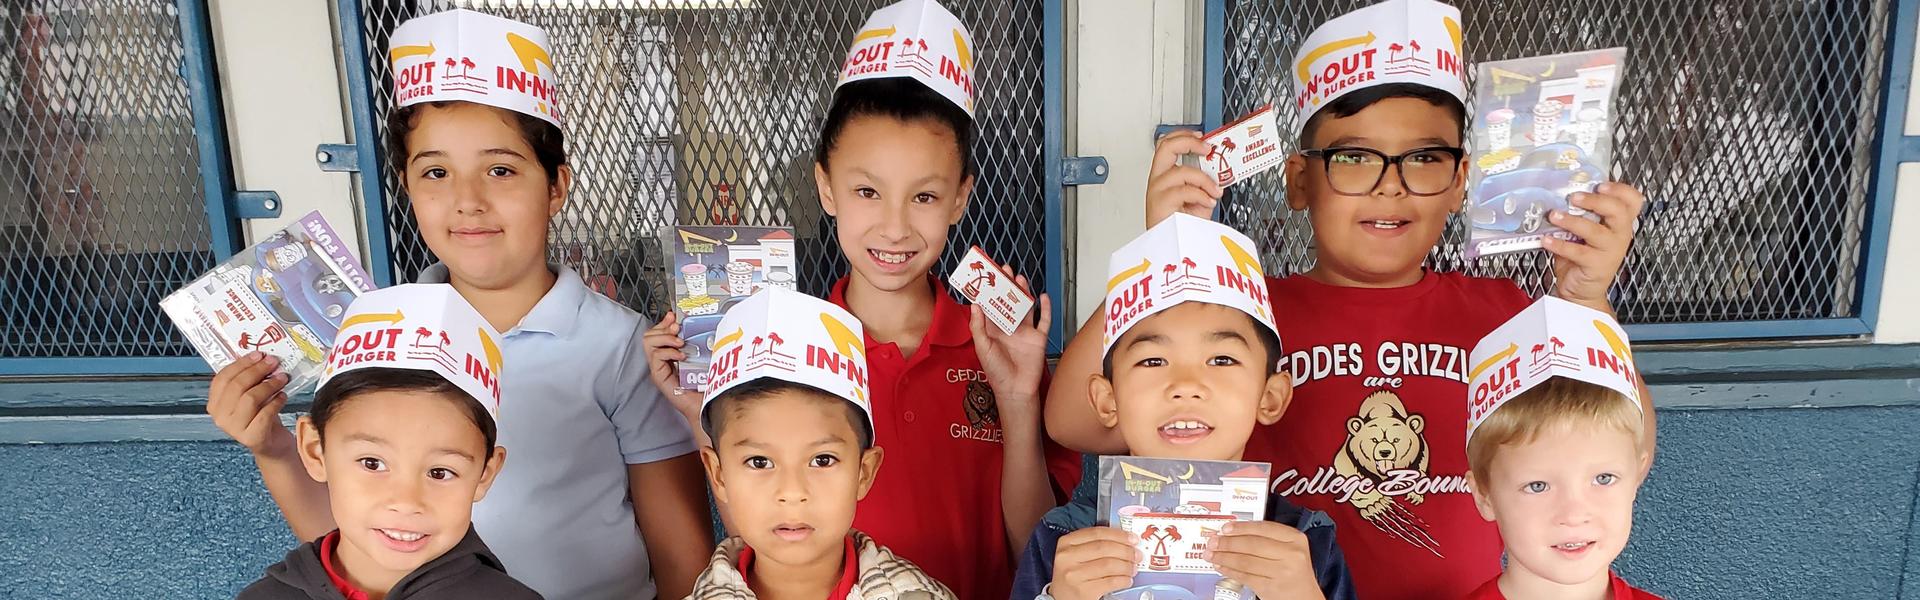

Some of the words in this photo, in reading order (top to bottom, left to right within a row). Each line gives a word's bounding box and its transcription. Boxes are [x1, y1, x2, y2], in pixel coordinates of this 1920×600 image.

[1324, 71, 1376, 98] BURGER
[307, 219, 339, 255] FUN!
[1112, 298, 1153, 336] BURGER
[337, 351, 397, 369] BURGER
[1377, 341, 1470, 384] GRIZZL
[946, 368, 988, 383] GEDD
[1363, 376, 1403, 388] are
[1475, 379, 1522, 421] BURGER
[950, 423, 1004, 444] GRIZZLIE
[1270, 467, 1375, 502] College
[1192, 543, 1207, 551] AWA
